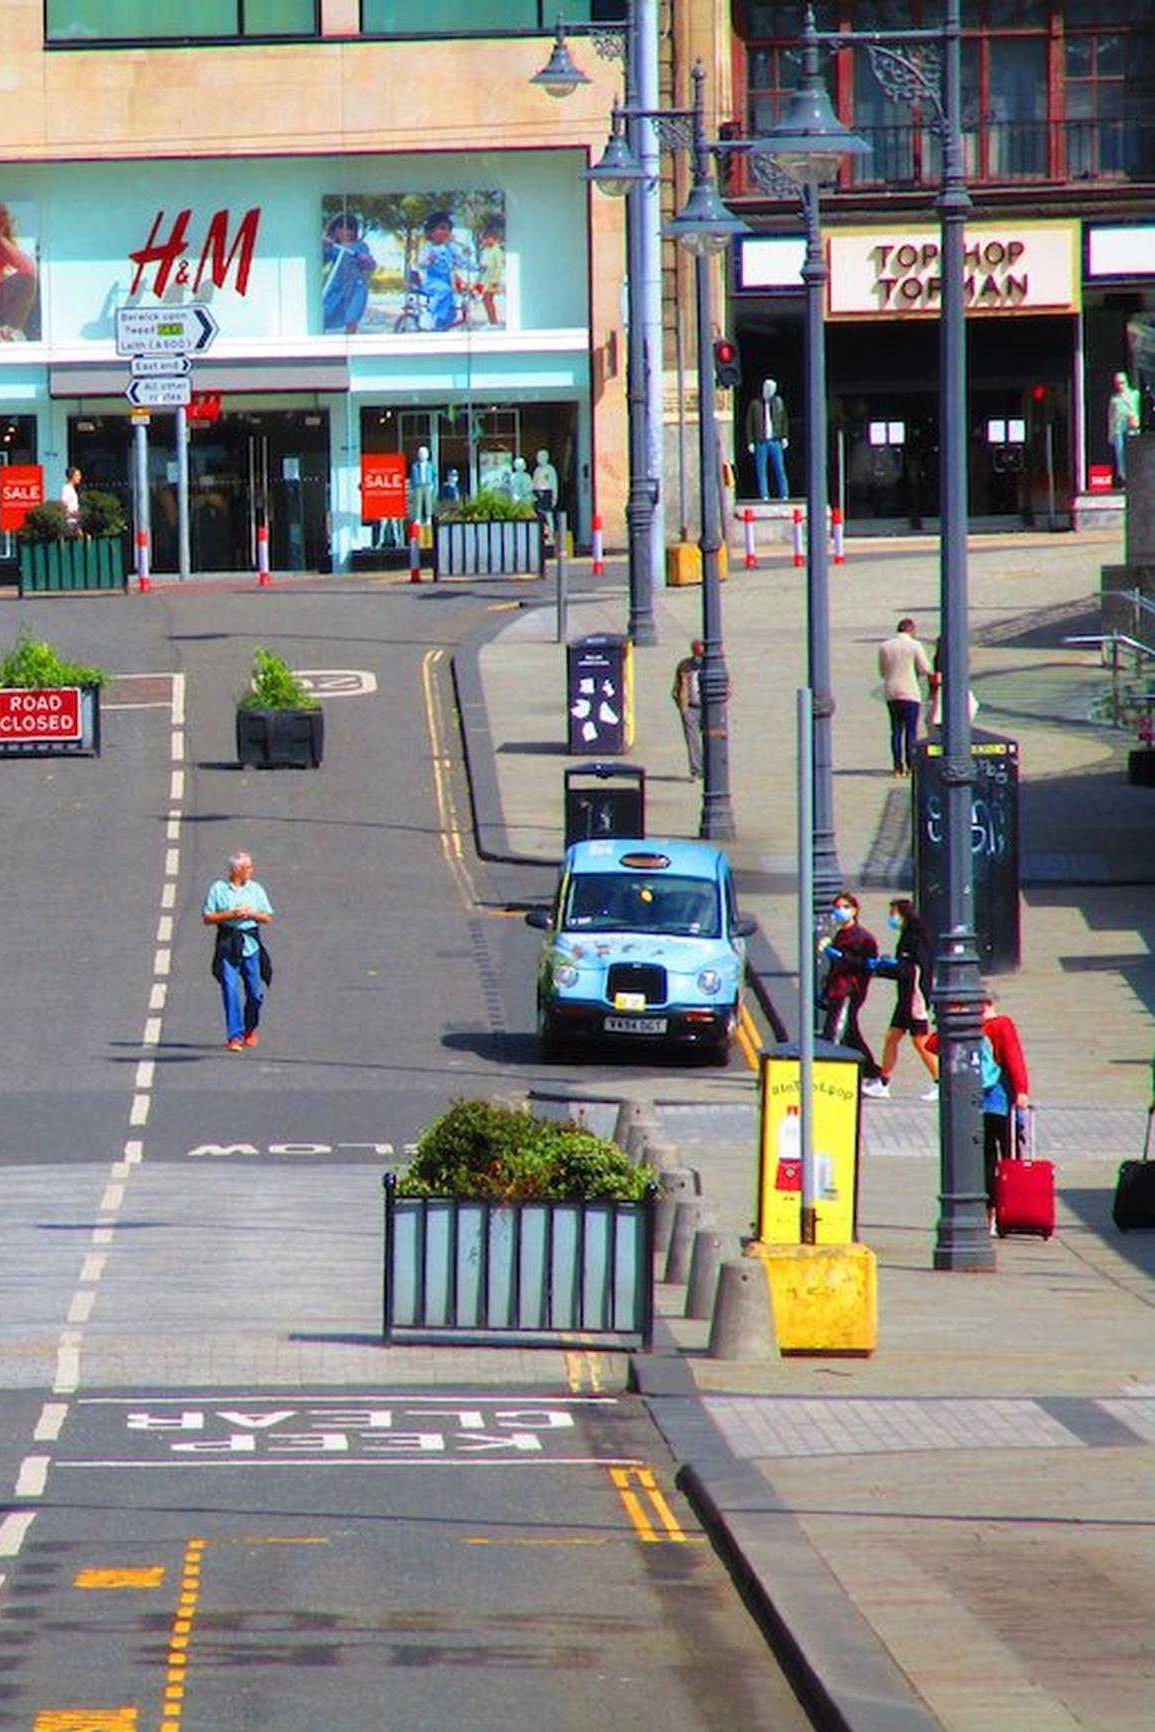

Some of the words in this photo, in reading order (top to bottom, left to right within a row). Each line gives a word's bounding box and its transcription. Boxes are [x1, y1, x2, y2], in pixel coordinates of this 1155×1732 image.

[129, 207, 261, 298] H&M
[875, 241, 1025, 267] TOPHOP
[121, 312, 158, 321] Berwick
[162, 312, 187, 322] upon
[126, 325, 155, 334] Tweed
[122, 341, 146, 350] Leith
[135, 362, 158, 371] East
[161, 360, 180, 369] end
[161, 382, 187, 391] other
[365, 473, 403, 488] SALE
[3, 485, 41, 500] SALE
[10, 695, 62, 711] ROAD
[0, 714, 74, 731] CLOSED
[127, 1410, 575, 1429] CLEAR
[171, 1433, 542, 1452] KEEP
